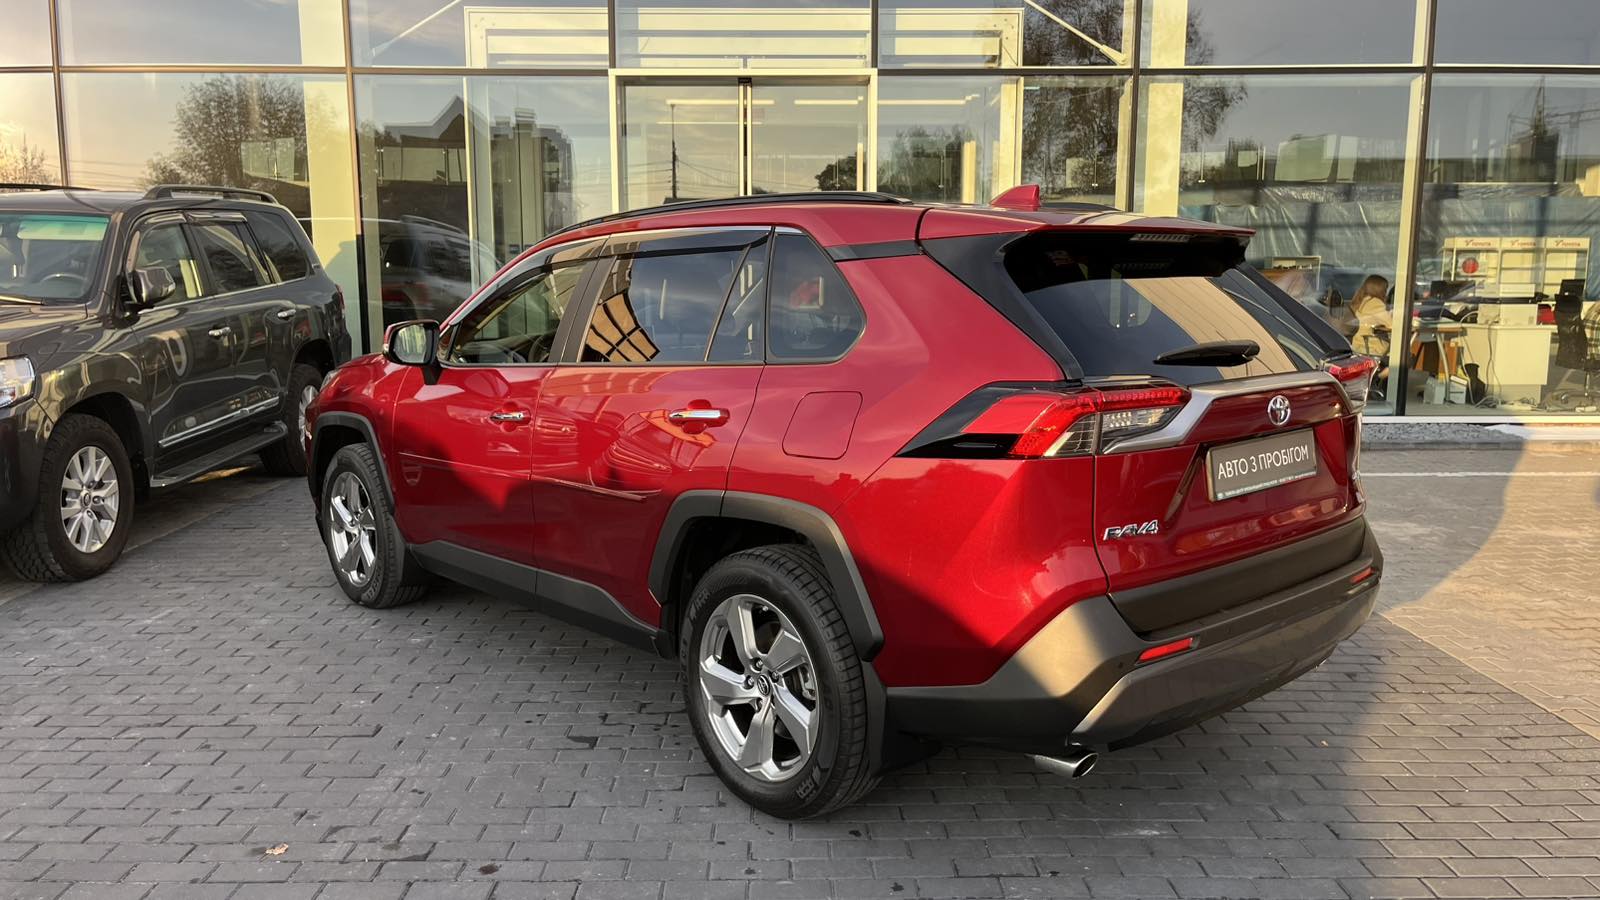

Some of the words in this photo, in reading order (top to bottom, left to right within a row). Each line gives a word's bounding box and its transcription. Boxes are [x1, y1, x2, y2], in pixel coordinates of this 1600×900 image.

[1218, 458, 1249, 479] АВТО
[1258, 444, 1309, 471] ПРОБІГОМ
[1103, 519, 1159, 541] RAV4
